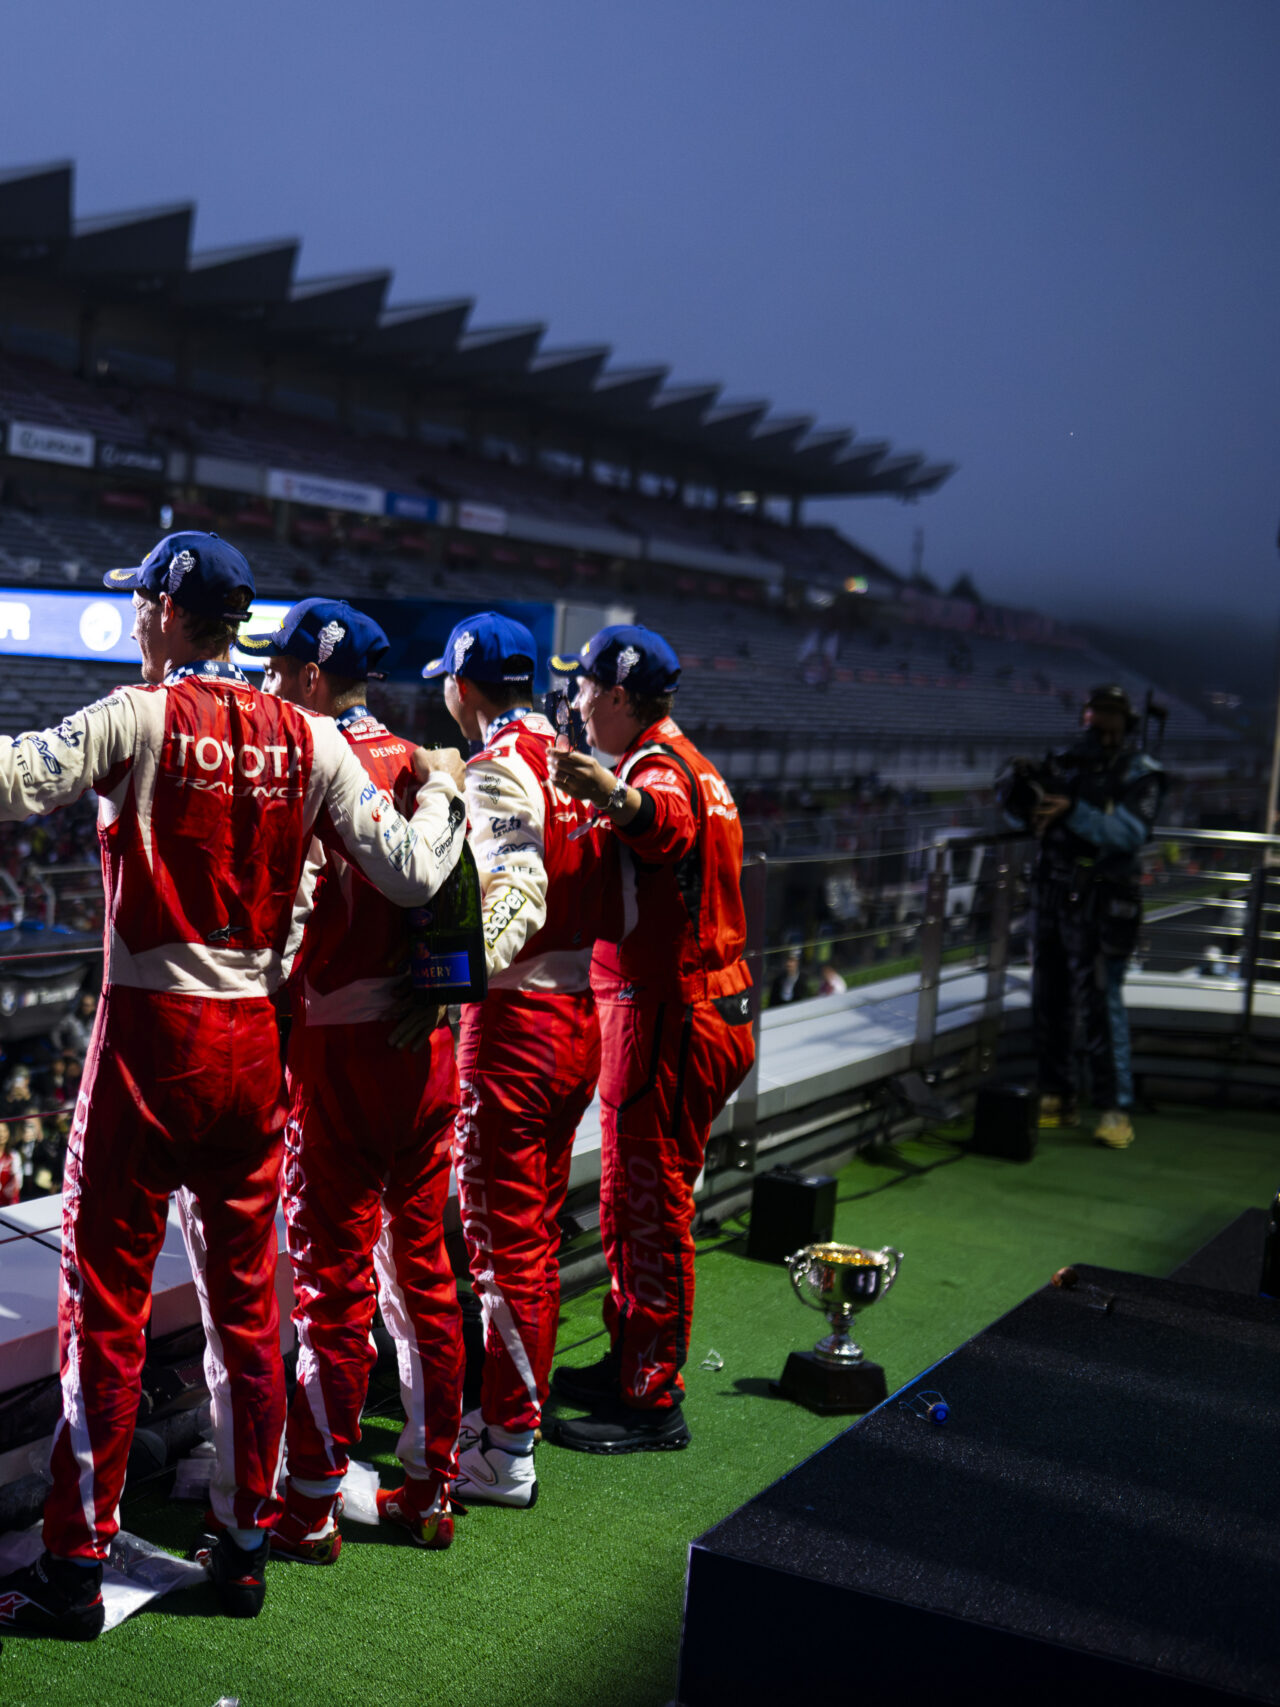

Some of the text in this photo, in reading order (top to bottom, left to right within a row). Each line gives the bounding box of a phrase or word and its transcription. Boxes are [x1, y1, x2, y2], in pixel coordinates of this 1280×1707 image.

[369, 743, 407, 758] DENSO
[483, 886, 526, 946] eePer
[627, 1154, 667, 1308] DENSO
